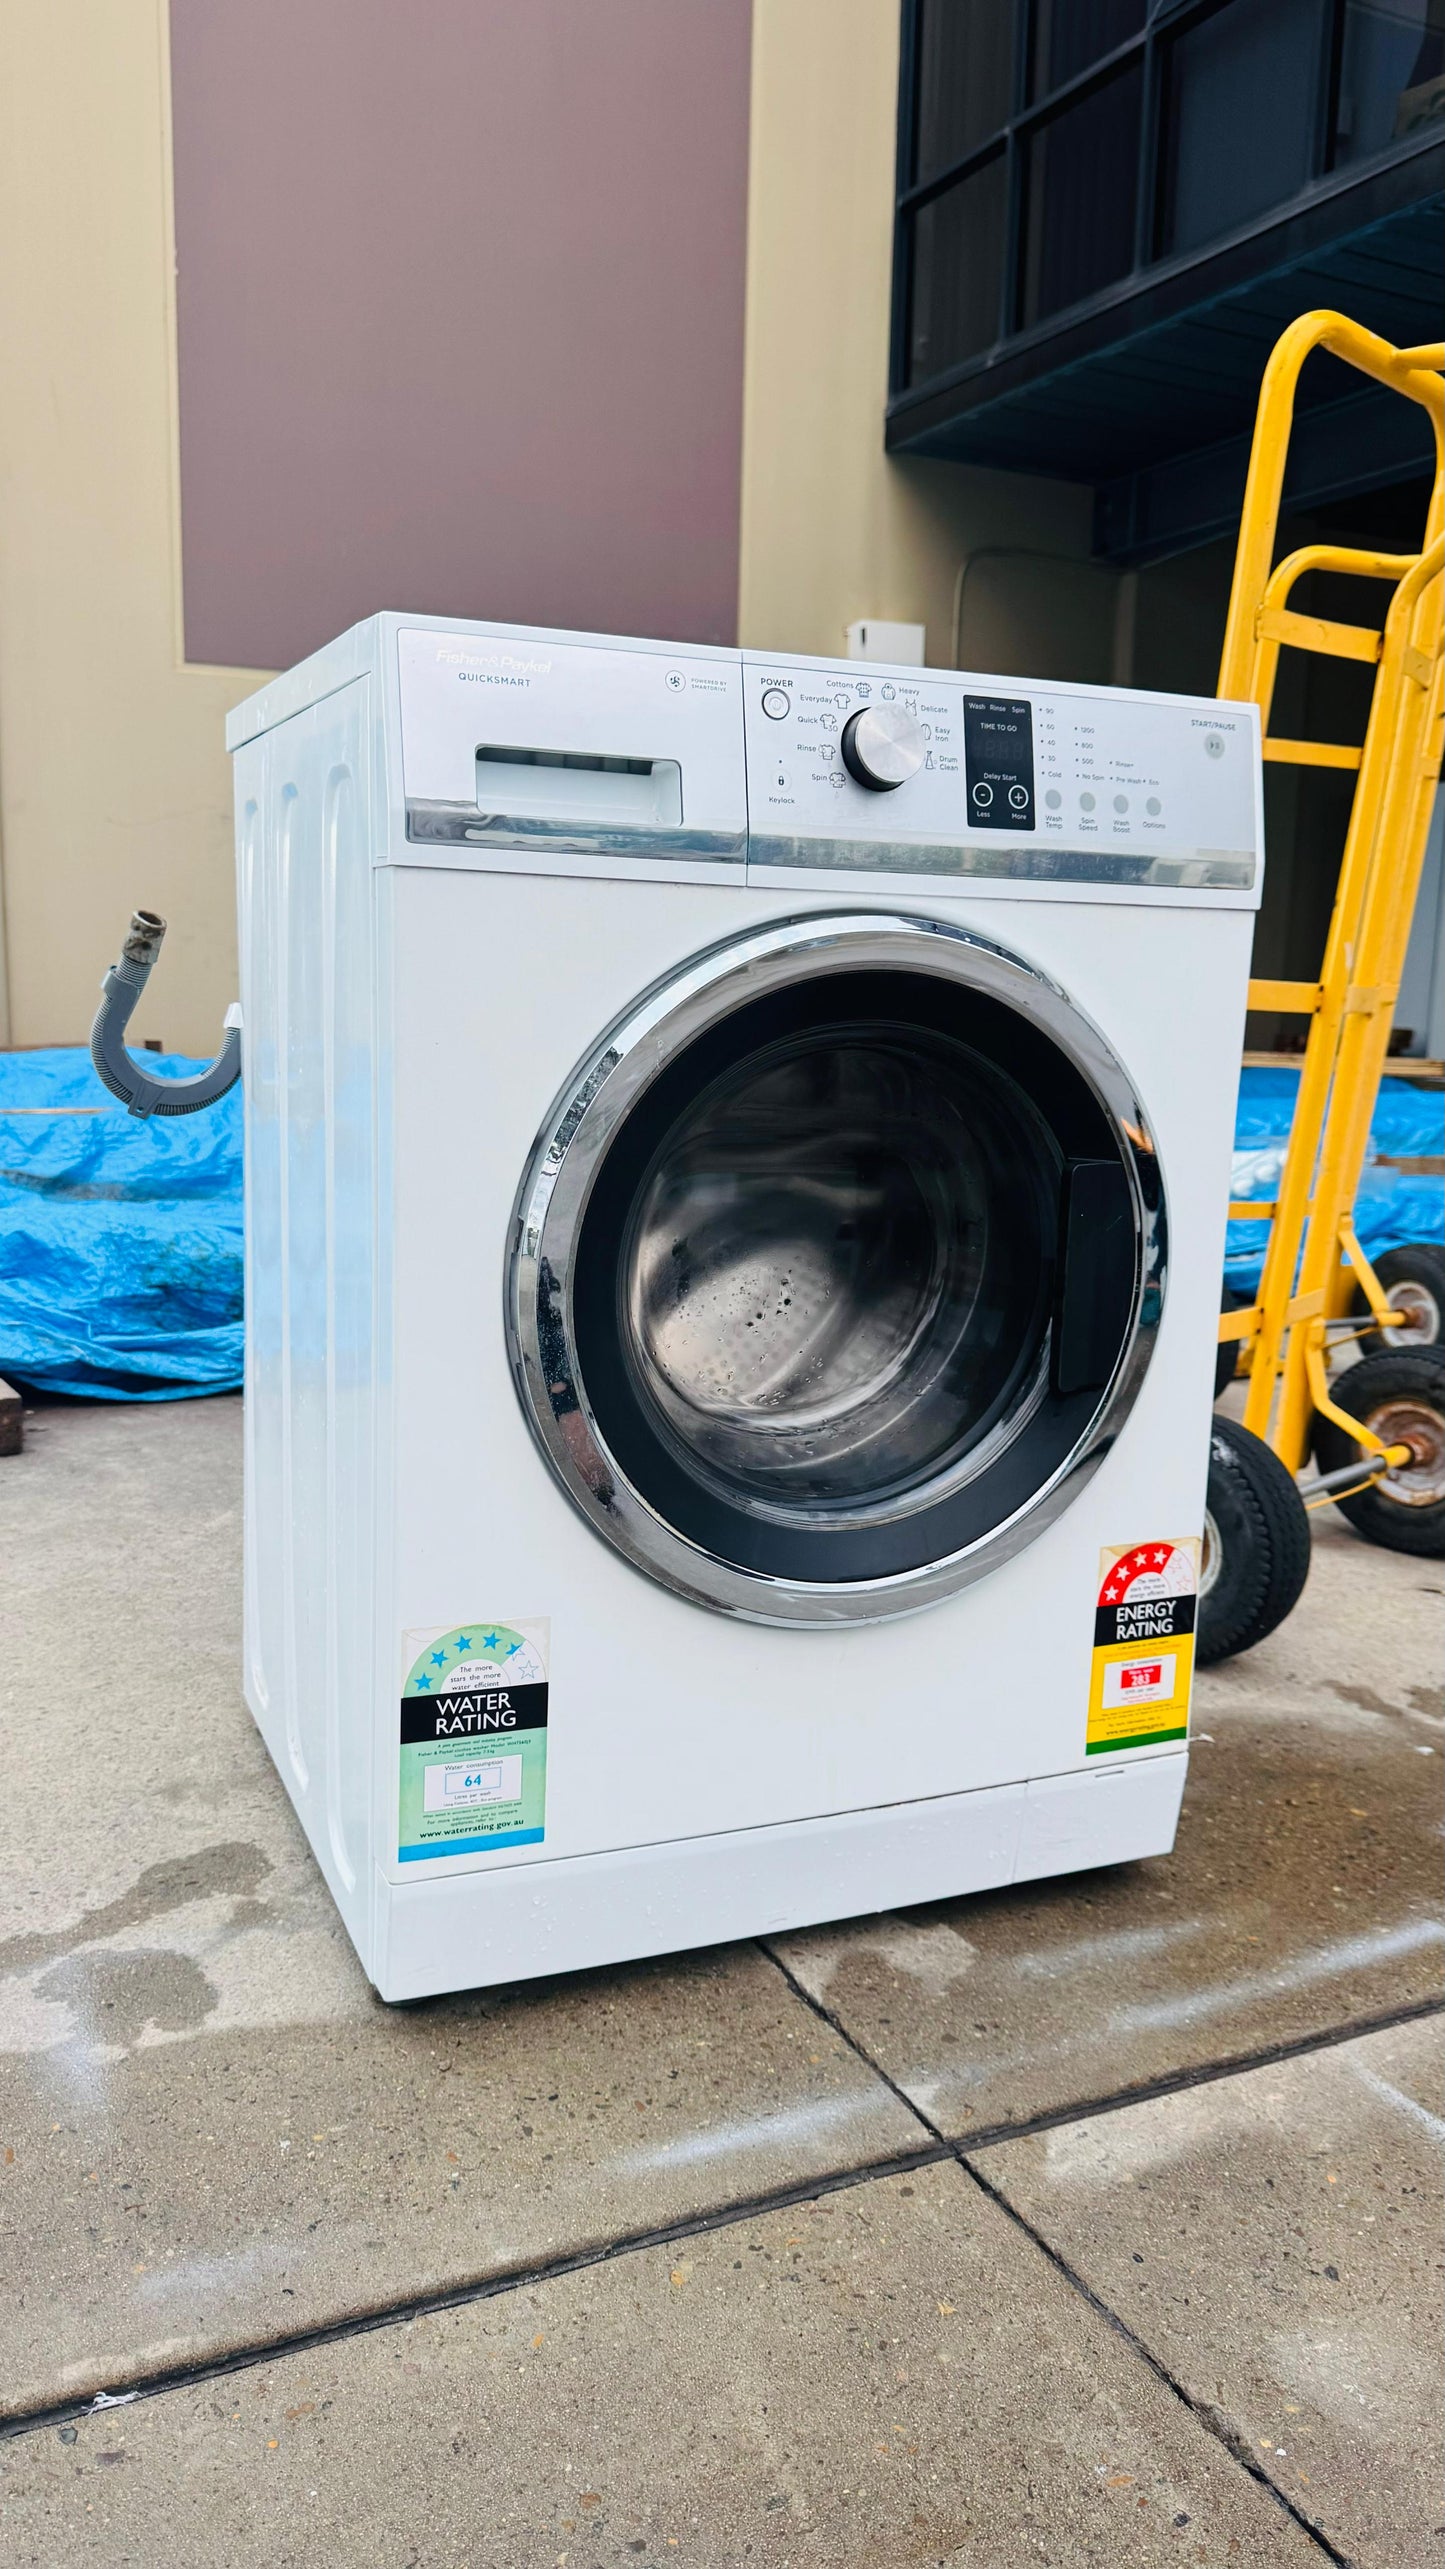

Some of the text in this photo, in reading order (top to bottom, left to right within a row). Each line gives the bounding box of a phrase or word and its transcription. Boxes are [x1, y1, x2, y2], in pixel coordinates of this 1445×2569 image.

[458, 672, 531, 688] QUICKSMART
[691, 678, 719, 686] POWERED
[760, 677, 794, 688] POWER
[826, 680, 854, 690] Cottons
[691, 684, 727, 693] SMARTDRIVE
[899, 687, 920, 697] Heavy
[800, 694, 833, 705] Everyday
[920, 704, 948, 714] Delicate
[968, 702, 1026, 716] Wash Rinse Spin
[797, 716, 818, 726] Quick
[1191, 719, 1236, 732] START/PAUSE
[828, 725, 839, 733] 30
[935, 726, 951, 736] Easy
[980, 722, 1018, 733] TIME TO GO
[935, 734, 949, 743] Iron
[1047, 739, 1057, 747] 40
[797, 743, 817, 753] Rinse
[939, 755, 958, 764] Drum
[939, 763, 959, 772] Clean
[811, 773, 828, 783] Spin
[983, 772, 1017, 782] Delay Start
[1048, 771, 1062, 779] Cold
[768, 796, 795, 806] Keylock
[976, 810, 991, 818] Less
[1011, 812, 1027, 821] More
[1045, 815, 1063, 823] Wash
[1046, 822, 1063, 830] Temp
[1081, 818, 1095, 826] Spin
[1113, 819, 1130, 827] Wash
[1142, 821, 1166, 830] Options
[1078, 824, 1098, 832] Speed
[1116, 1600, 1176, 1622] ENERGY
[1116, 1618, 1173, 1640] RATING
[1131, 1674, 1151, 1687] 283
[436, 1692, 511, 1716] WATER
[436, 1710, 516, 1735] RATING
[467, 1760, 503, 1769] consumption
[464, 1774, 482, 1787] 64
